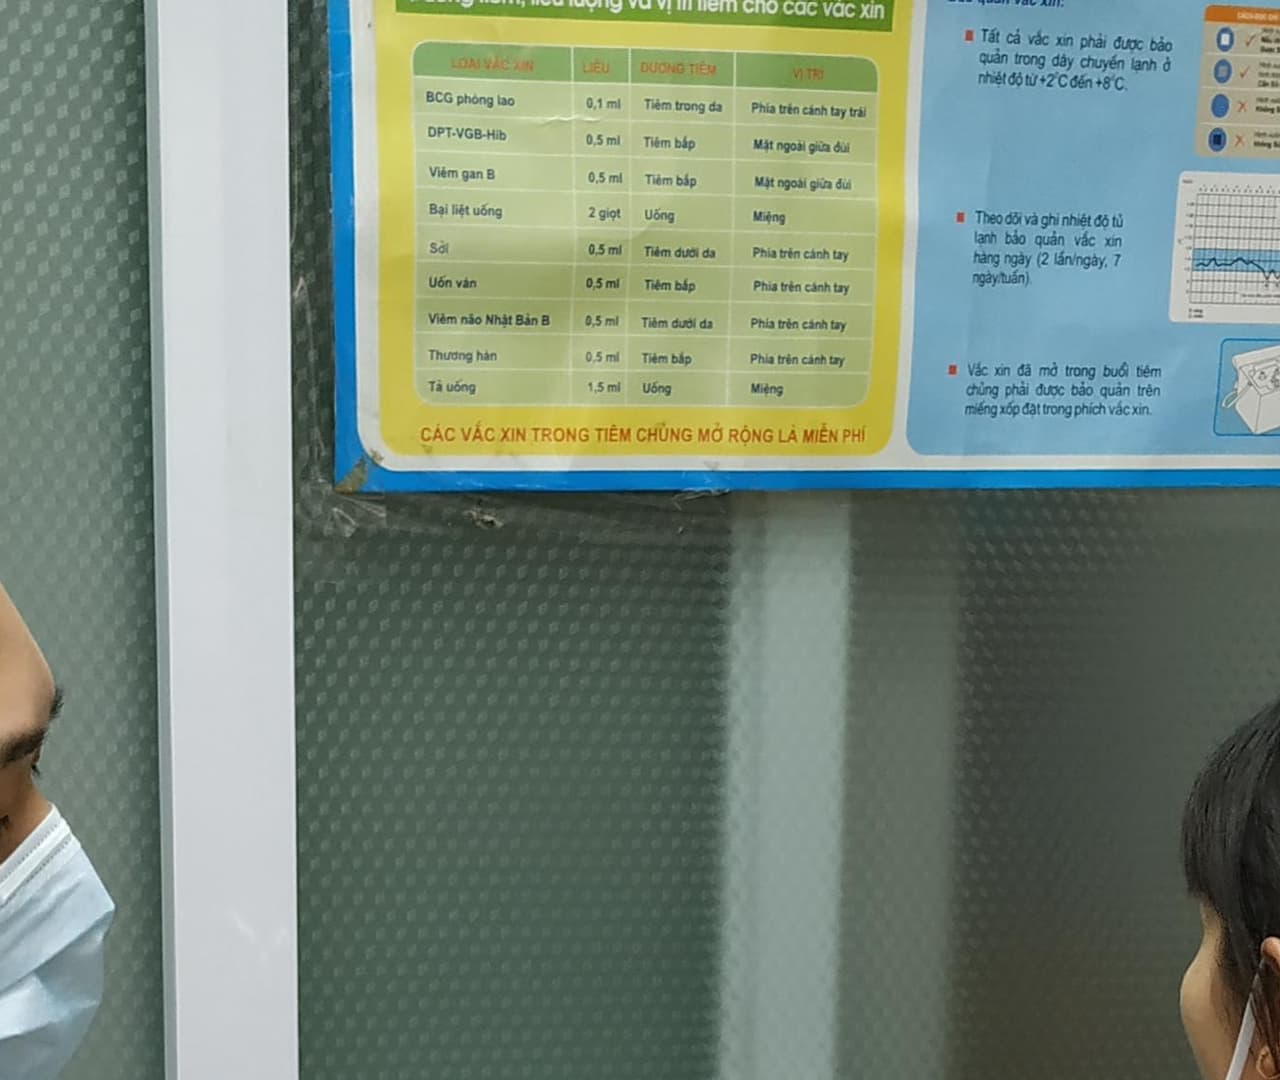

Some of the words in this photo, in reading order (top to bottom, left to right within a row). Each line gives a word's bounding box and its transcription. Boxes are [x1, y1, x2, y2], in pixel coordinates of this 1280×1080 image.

[980, 27, 1001, 43] Tất
[1006, 29, 1022, 45] cả
[1027, 28, 1050, 46] vắc
[1055, 32, 1074, 48] xin
[1080, 33, 1108, 50] phải
[1113, 36, 1144, 52] được
[1150, 35, 1173, 52] bảo
[426, 91, 453, 104] BCG
[456, 93, 495, 109] phòng
[497, 94, 516, 107] lao
[586, 97, 604, 110] 0,1
[606, 97, 622, 109] ml
[644, 98, 672, 112] Tiêm
[674, 100, 706, 115] trong
[708, 100, 723, 113] da
[427, 126, 508, 142] DPT-VGB-Hib
[586, 133, 604, 147] 0,5
[606, 134, 621, 147] ml
[429, 165, 459, 179] Viêm
[462, 169, 484, 182] gan
[486, 168, 496, 180] B
[429, 203, 449, 219] Bại
[451, 203, 470, 219] liệt
[473, 203, 503, 220] uống
[588, 206, 596, 219] 2
[599, 207, 622, 222] giọt
[644, 207, 676, 225] Uống
[753, 210, 787, 226] Miệng
[975, 210, 1003, 226] Theo
[1005, 211, 1022, 226] dõi
[1024, 211, 1039, 227] và
[1040, 212, 1060, 230] ghi
[1061, 212, 1092, 230] nhiệt
[1093, 213, 1110, 230] độ
[1112, 212, 1125, 229] tủ
[1004, 229, 1027, 246] bảo
[1034, 230, 1066, 249] quản
[1074, 230, 1097, 248] vắc
[1104, 234, 1123, 248] xin
[588, 244, 606, 257] 0,5
[608, 244, 623, 256] ml
[428, 312, 458, 326] Viêm
[460, 313, 483, 326] não
[485, 313, 513, 329] Nhật
[515, 313, 539, 327] Bản
[541, 314, 551, 327] B
[967, 361, 989, 377] Vắc
[993, 363, 1011, 377] xin
[1017, 362, 1032, 378] đã
[1039, 361, 1059, 377] mở
[1065, 365, 1096, 381] trong
[1102, 360, 1129, 379] buổi
[1136, 363, 1162, 379] tiêm
[966, 381, 1000, 400] chủng
[1004, 380, 1030, 399] phải
[1035, 382, 1066, 398] được
[1070, 381, 1095, 398] bảo
[1099, 381, 1131, 400] quản
[1137, 383, 1162, 398] trên
[420, 422, 456, 443] CÁC
[460, 419, 496, 443] VẮC
[500, 427, 527, 443] XIN
[531, 427, 590, 443] TRONG
[594, 423, 632, 443] TIÊM
[636, 422, 693, 444] CHỦNG
[697, 422, 724, 444] MỞ
[729, 424, 774, 447] RỘNG
[778, 424, 799, 444] LÀ
[803, 421, 839, 445] MIỄN
[842, 423, 866, 445] PHÍ
